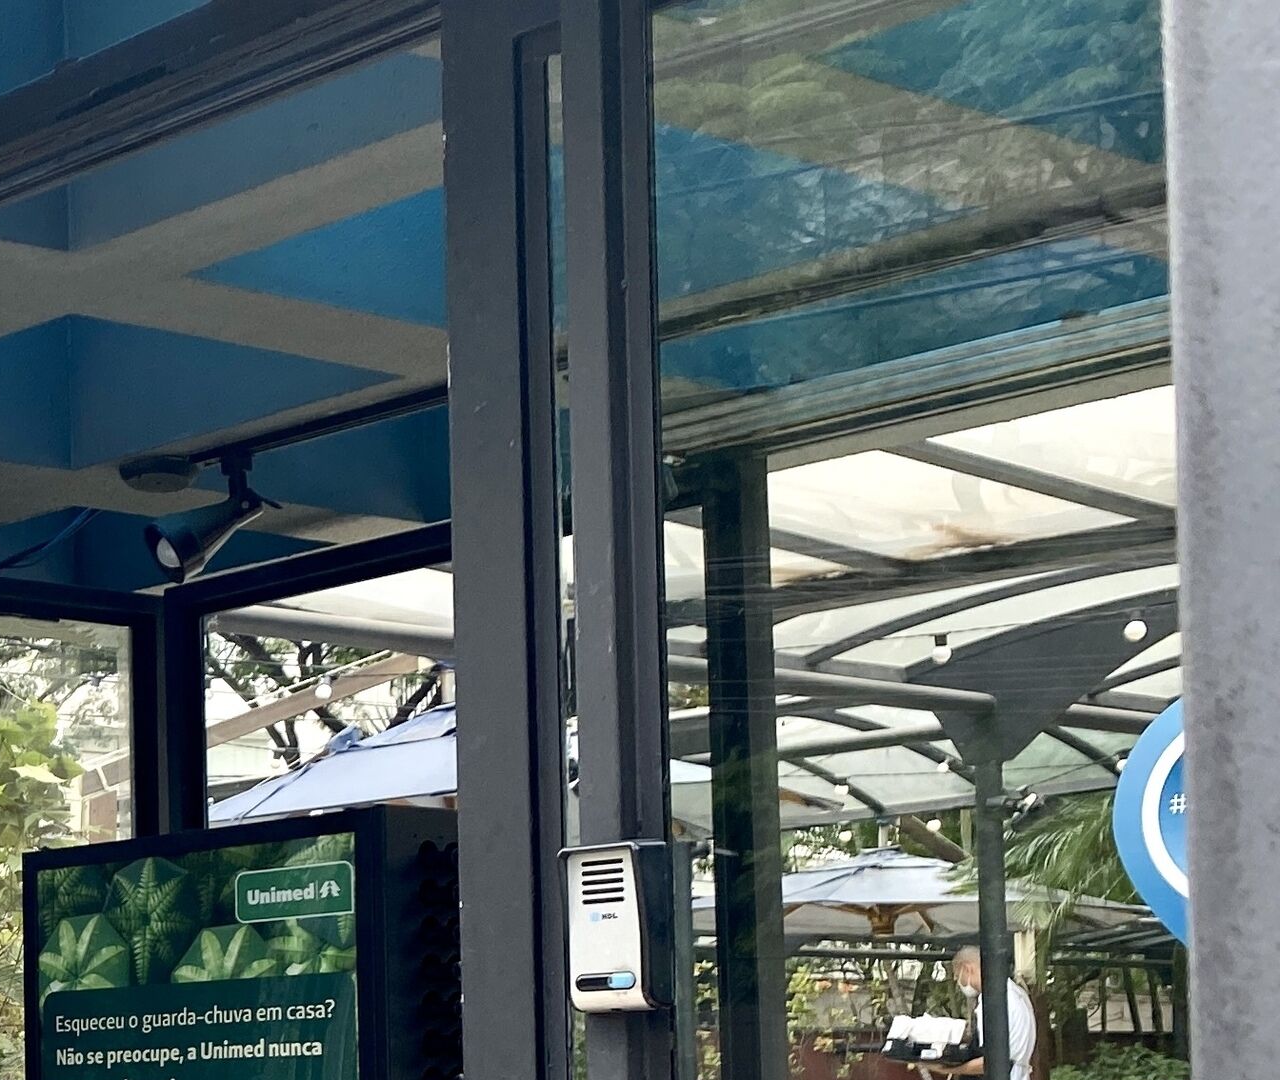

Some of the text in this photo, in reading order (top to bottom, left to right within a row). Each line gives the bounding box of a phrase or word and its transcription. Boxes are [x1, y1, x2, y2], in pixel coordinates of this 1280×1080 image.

[247, 882, 315, 905] Unimed
[55, 999, 335, 1037] Esqueceu o guarda-chuva em casa?
[56, 1038, 323, 1069] Não se preocupe, a Unimed nunca
